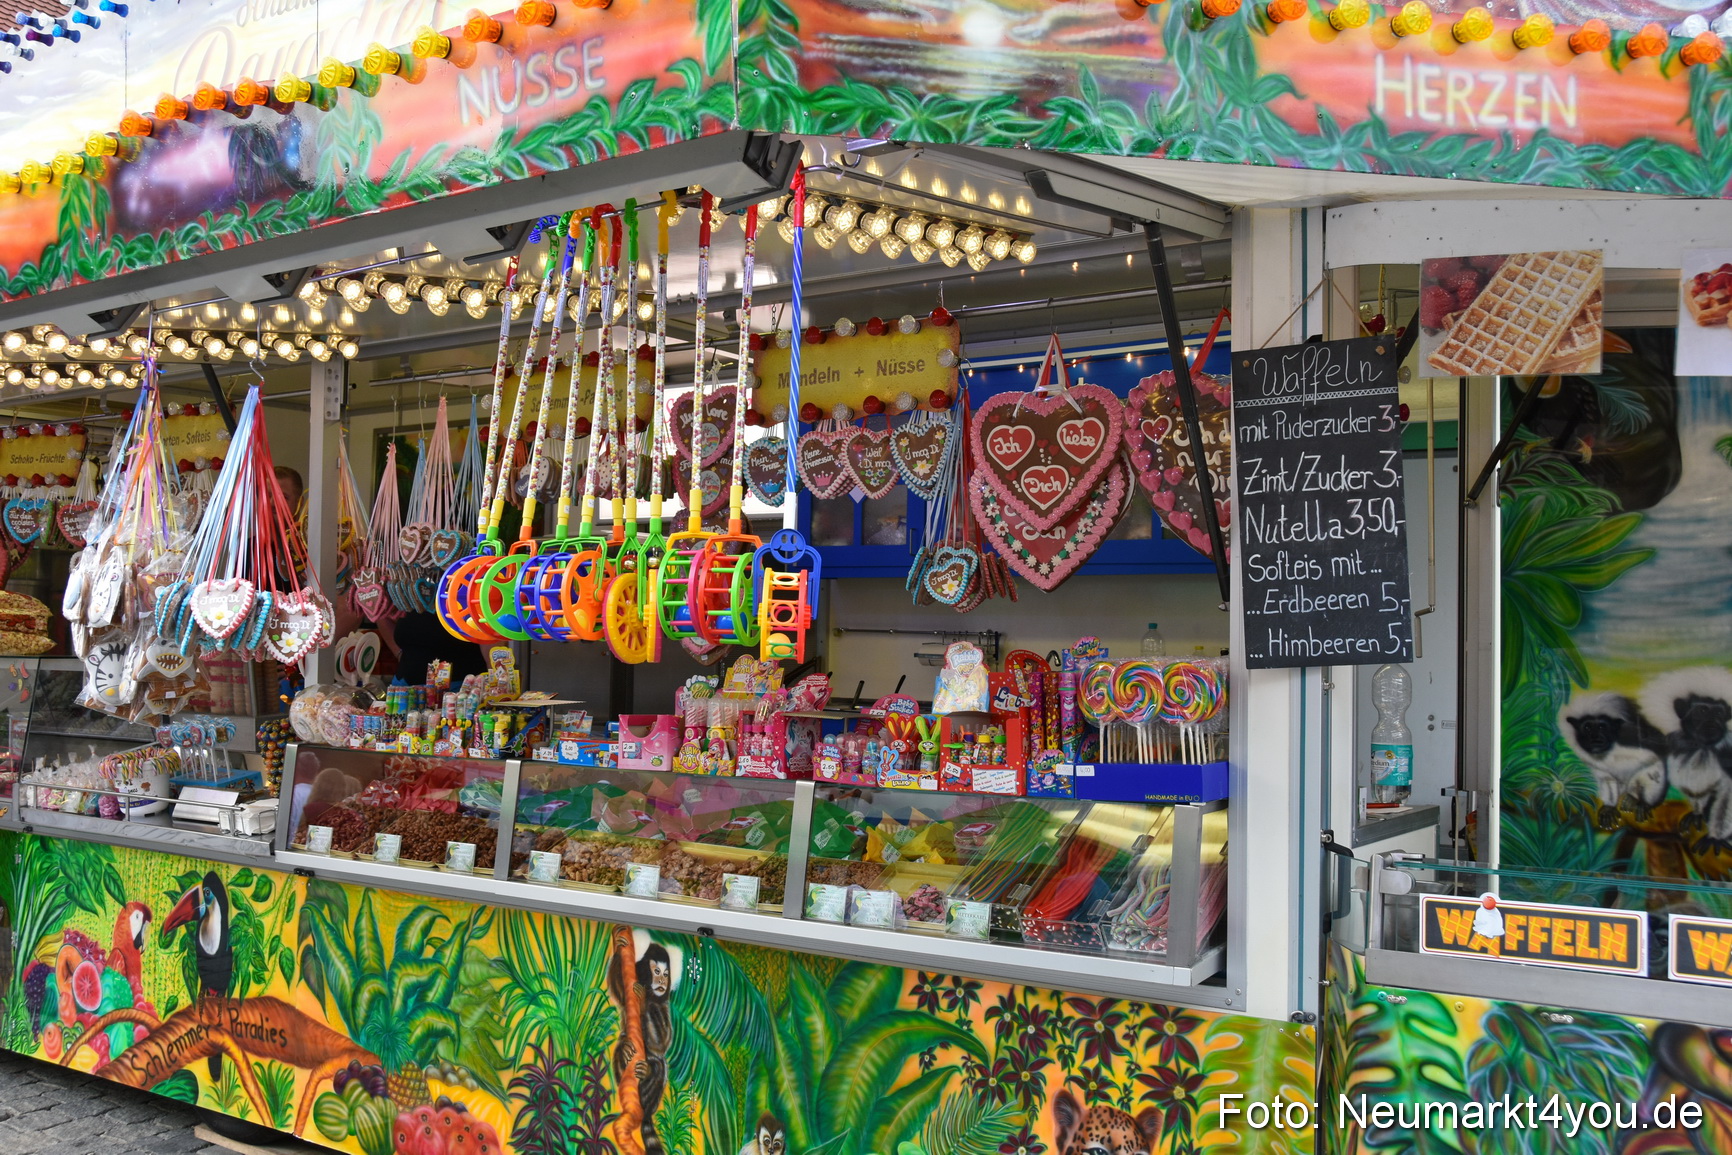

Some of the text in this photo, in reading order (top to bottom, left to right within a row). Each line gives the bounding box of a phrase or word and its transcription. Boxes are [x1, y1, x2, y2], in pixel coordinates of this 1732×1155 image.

[1375, 52, 1577, 129] HERZEN
[778, 366, 840, 389] Mndeln
[877, 358, 925, 377] Nüsse
[1253, 344, 1383, 406] Waffeln
[186, 429, 211, 445] Softeis
[1239, 414, 1270, 443] mit
[1272, 407, 1377, 441] Puderzucker
[10, 454, 34, 464] Schoko
[39, 453, 66, 464] Früchte
[864, 447, 883, 458] Weil
[864, 459, 874, 468] Di
[875, 460, 892, 470] mog
[912, 447, 930, 460] mog
[929, 443, 940, 454] Di
[1242, 451, 1374, 495] Zimt/Zucker
[1246, 499, 1345, 544] Nutella
[1248, 550, 1323, 582] Softeis
[228, 593, 240, 602] Di
[300, 619, 311, 629] Di
[130, 1007, 288, 1087] Schlemmer Paradies
